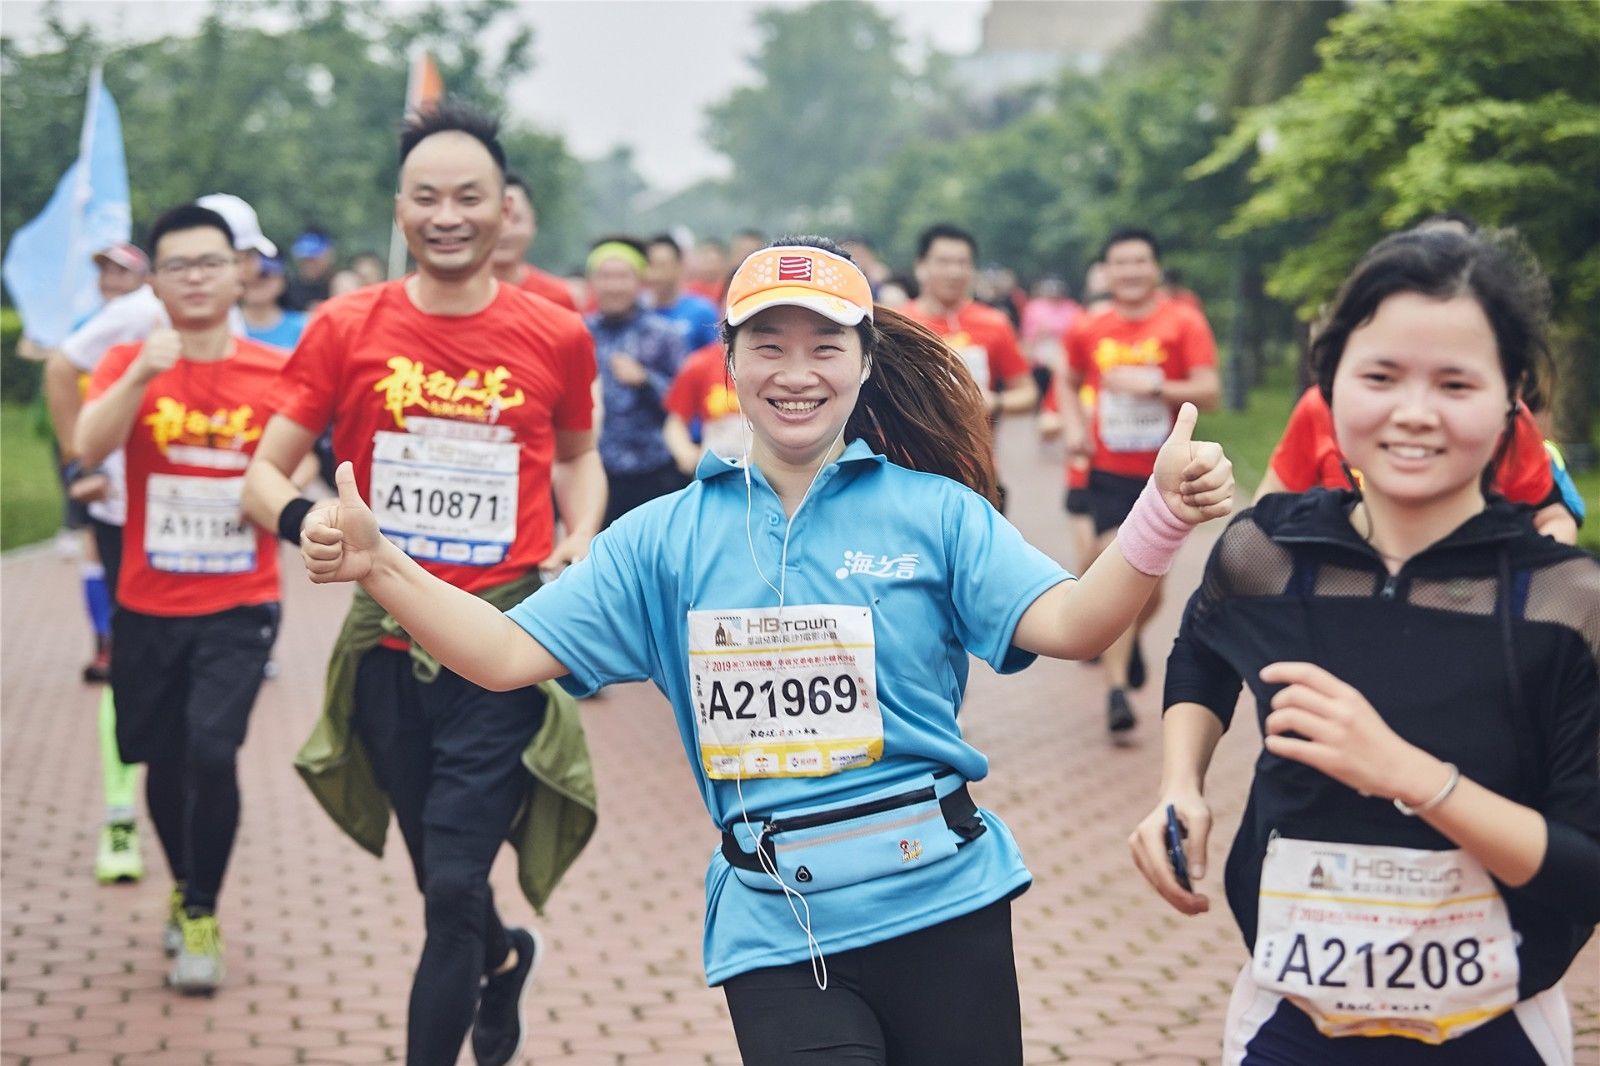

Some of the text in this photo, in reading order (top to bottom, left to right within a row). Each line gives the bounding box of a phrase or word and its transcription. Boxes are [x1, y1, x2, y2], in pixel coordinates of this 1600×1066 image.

[385, 485, 499, 522] A10871
[835, 550, 920, 580] 海之言
[709, 674, 858, 721] A21969
[1277, 933, 1485, 990] A21208
